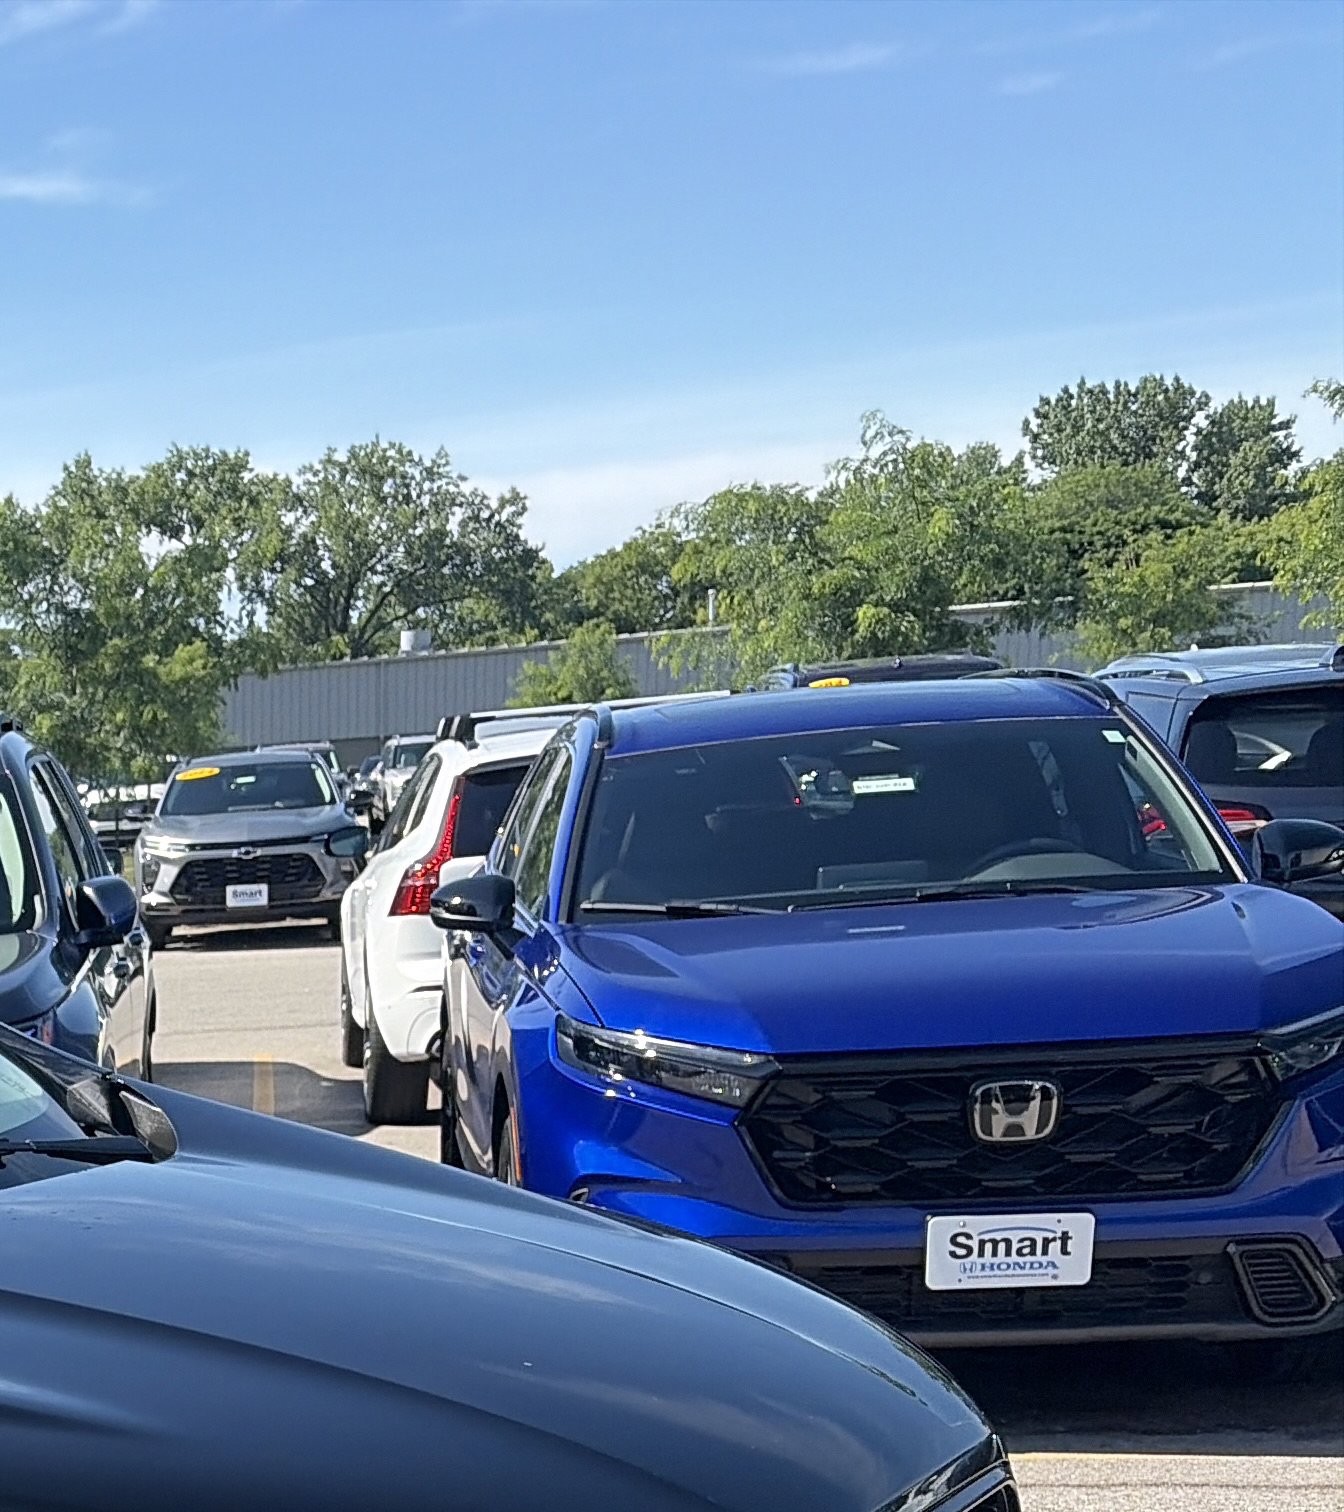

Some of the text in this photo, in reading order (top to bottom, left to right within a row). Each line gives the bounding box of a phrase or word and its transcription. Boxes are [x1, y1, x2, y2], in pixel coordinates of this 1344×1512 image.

[232, 888, 263, 899] Smart
[948, 1229, 1073, 1260] Smart
[980, 1260, 1060, 1273] HONDA
